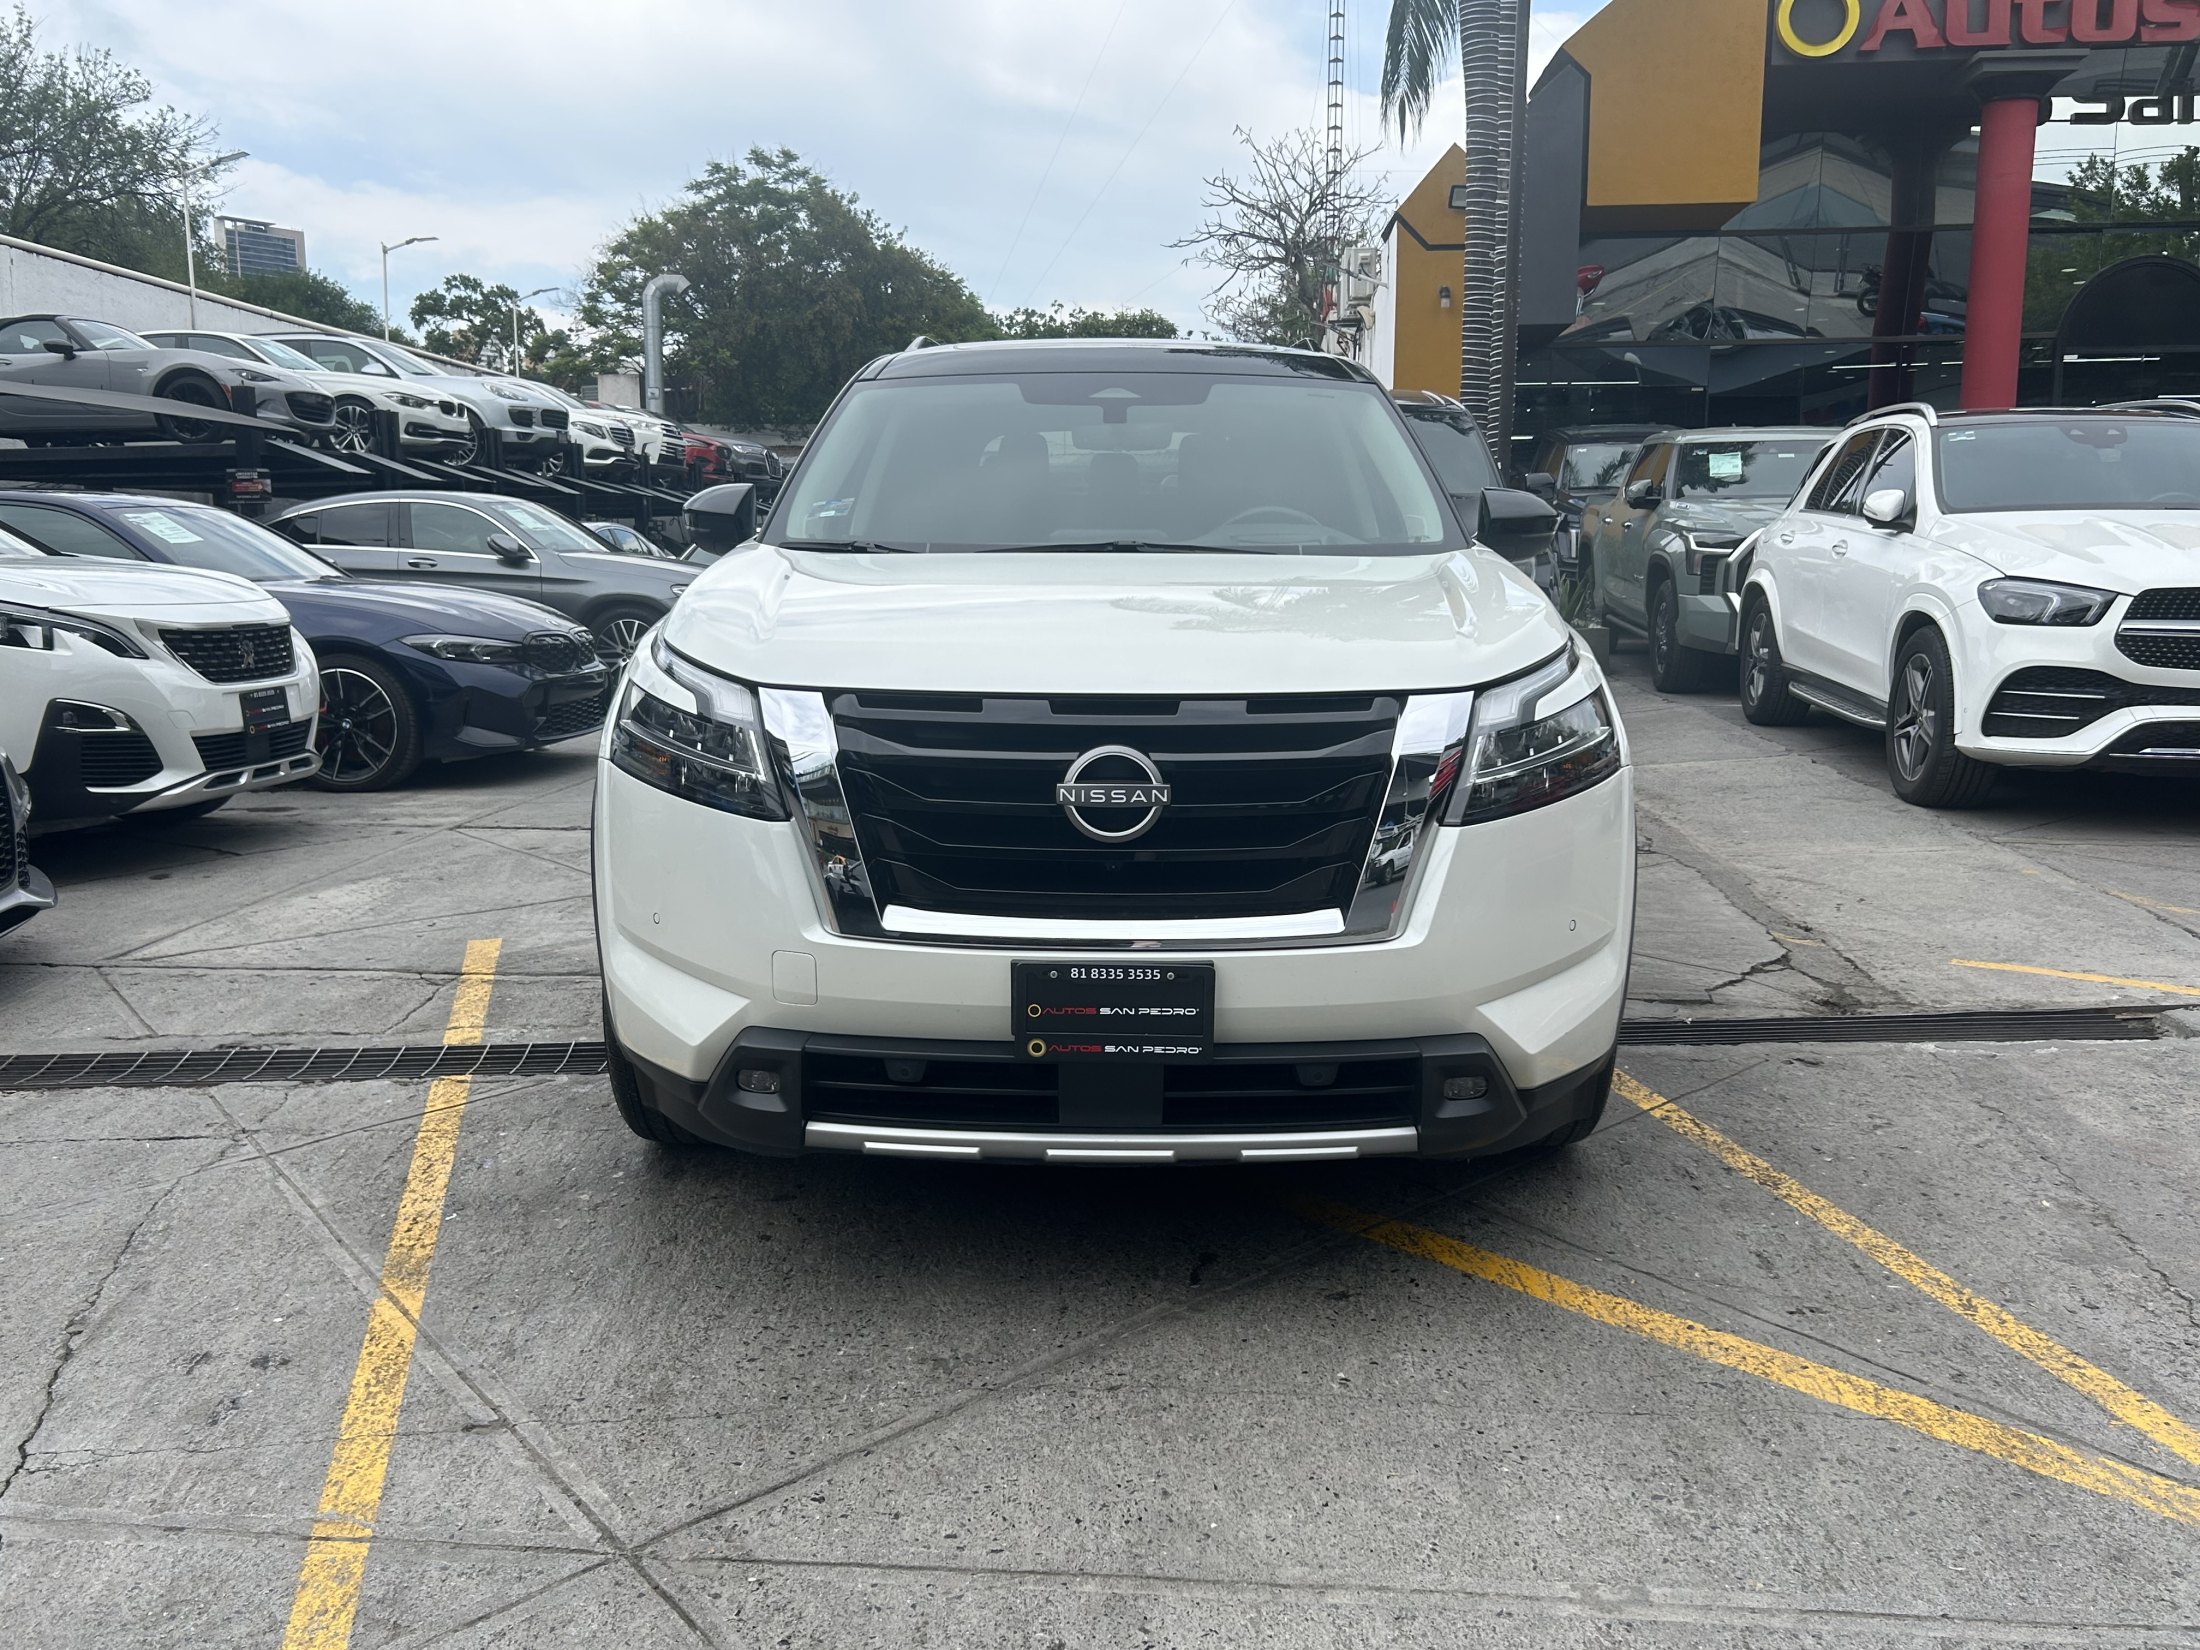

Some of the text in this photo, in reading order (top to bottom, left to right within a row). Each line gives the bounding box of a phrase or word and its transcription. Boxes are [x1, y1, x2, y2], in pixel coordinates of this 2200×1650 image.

[1859, 0, 2200, 50] Autos
[1059, 788, 1168, 803] NISSAN
[1070, 967, 1161, 980] 81 8335 3535
[1042, 1007, 1097, 1015] AUTOS
[1099, 1007, 1135, 1015] SAN
[1048, 1044, 1103, 1053] AUTOS
[1104, 1045, 1139, 1053] SAN
